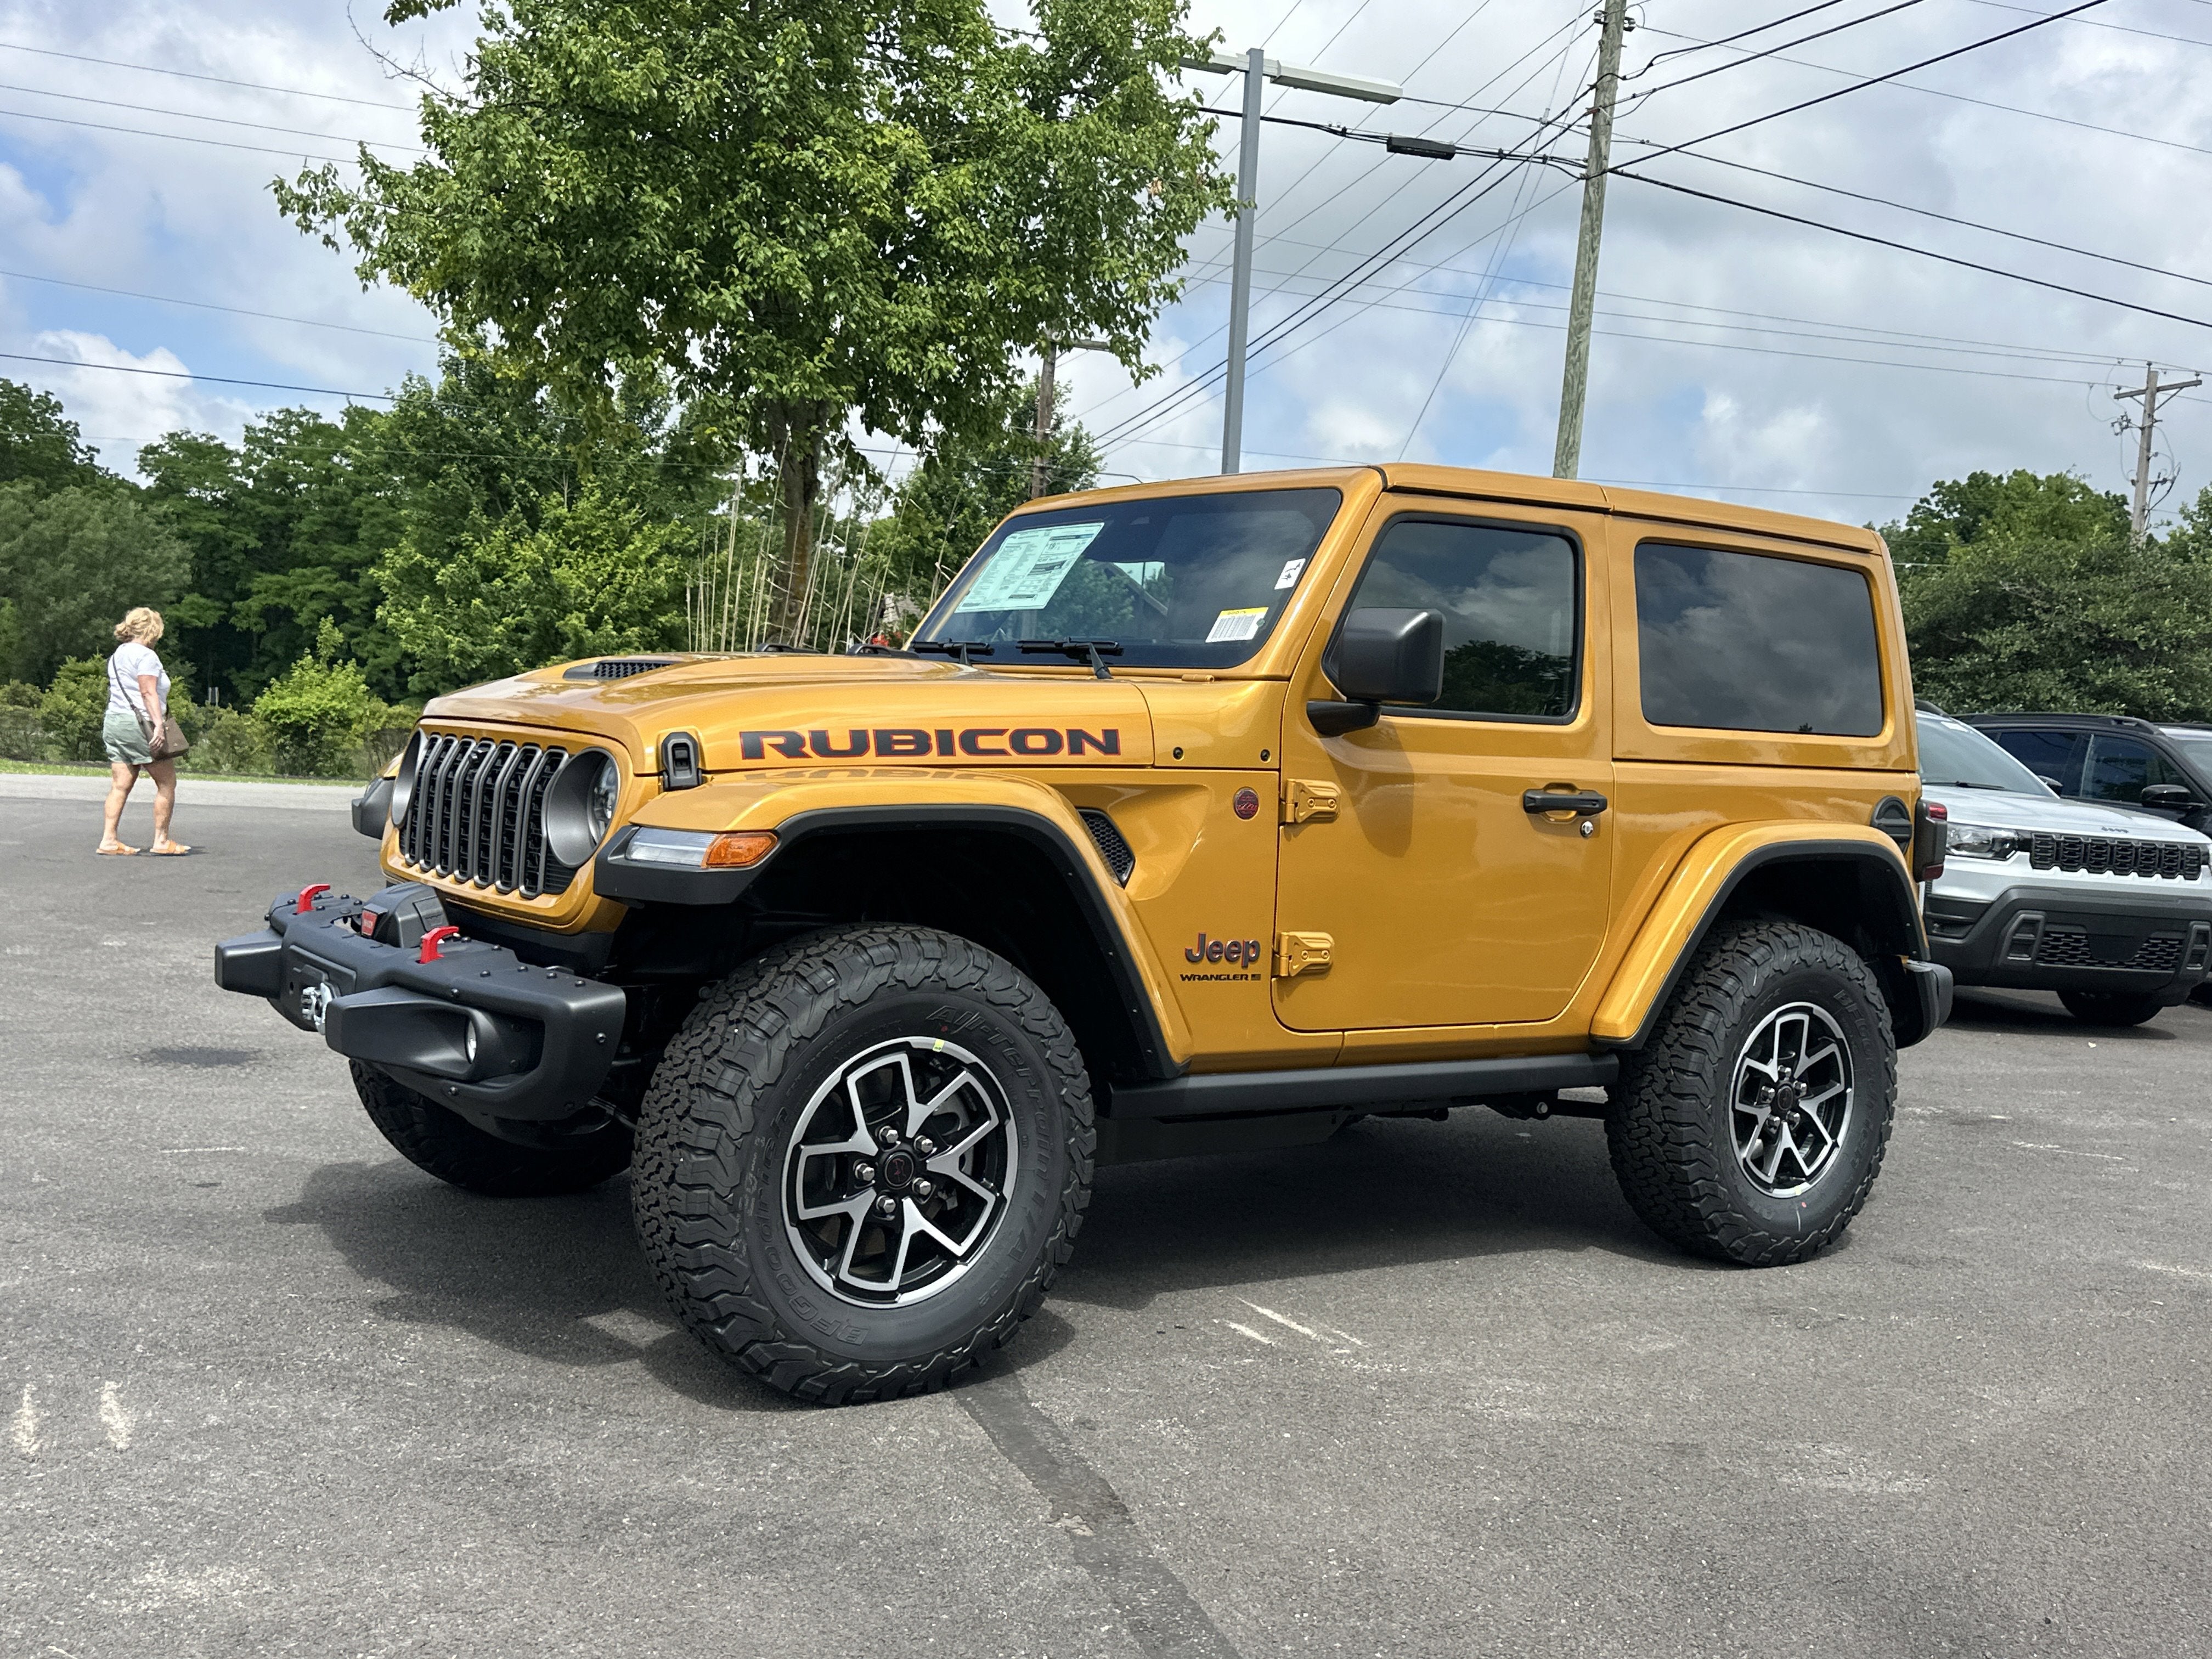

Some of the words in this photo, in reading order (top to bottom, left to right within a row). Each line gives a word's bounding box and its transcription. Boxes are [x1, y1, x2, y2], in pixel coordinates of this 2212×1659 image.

[739, 728, 1121, 760] RUBICON
[1185, 933, 1261, 969] Jeep
[755, 1105, 870, 1345] BFGoodrich
